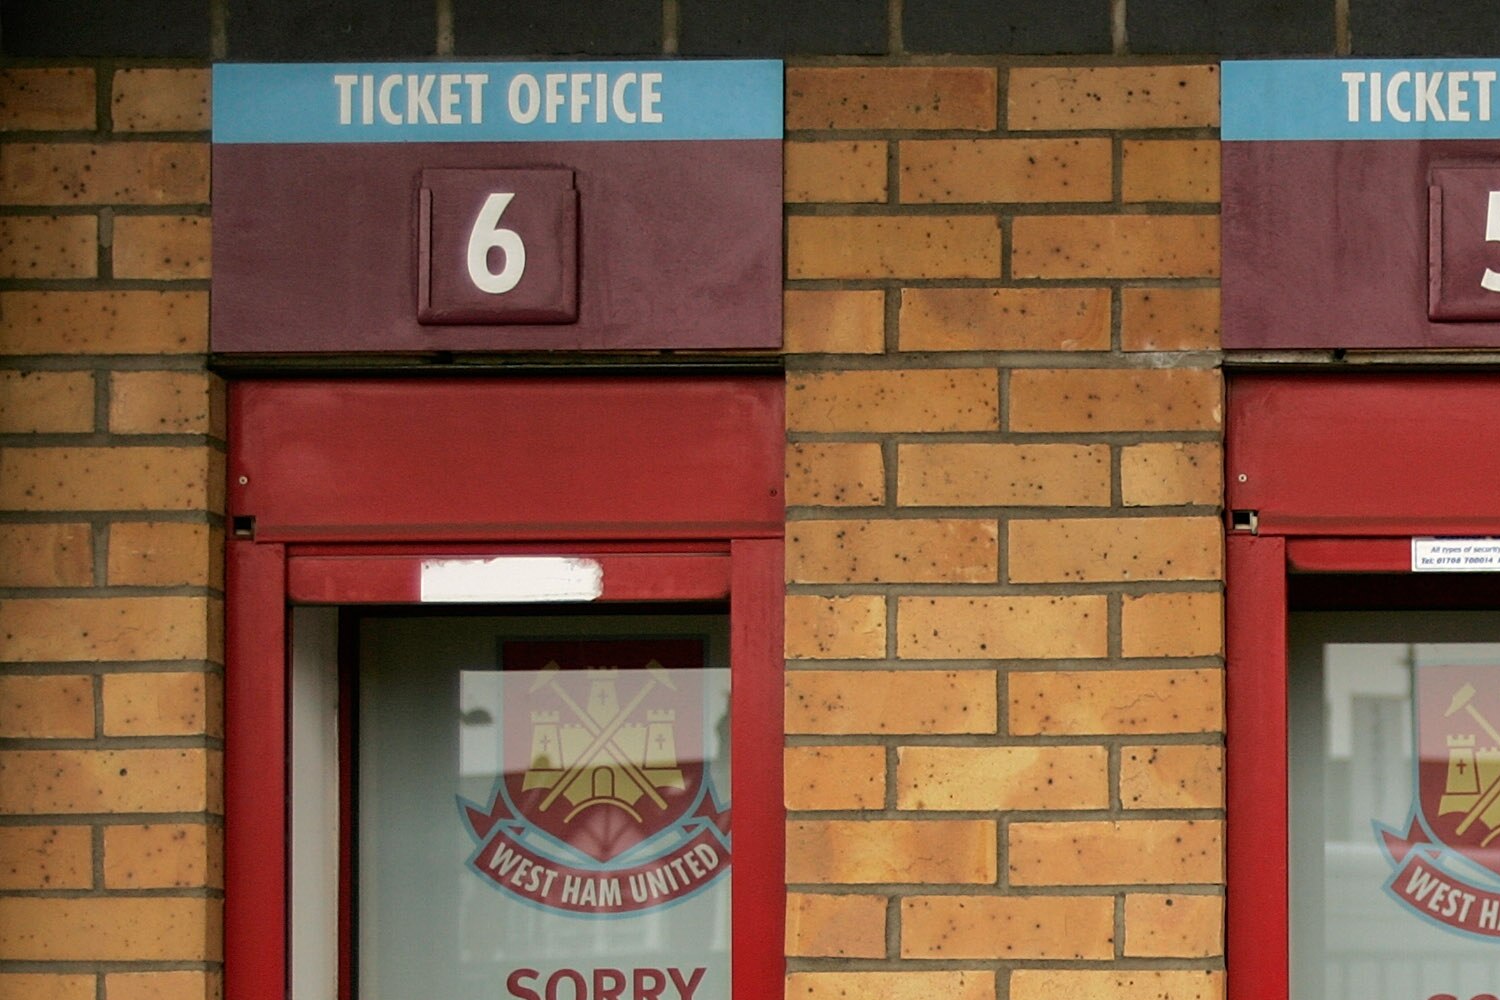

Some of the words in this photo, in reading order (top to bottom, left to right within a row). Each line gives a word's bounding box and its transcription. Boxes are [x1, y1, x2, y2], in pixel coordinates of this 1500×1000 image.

[334, 74, 488, 125] TICKET
[508, 72, 664, 124] OFFICE
[1341, 71, 1497, 123] TICKET
[467, 192, 526, 294] 6
[488, 840, 559, 899] WEST
[560, 876, 623, 908] HAM
[630, 842, 720, 904] UNITED
[1404, 865, 1476, 925] WEST
